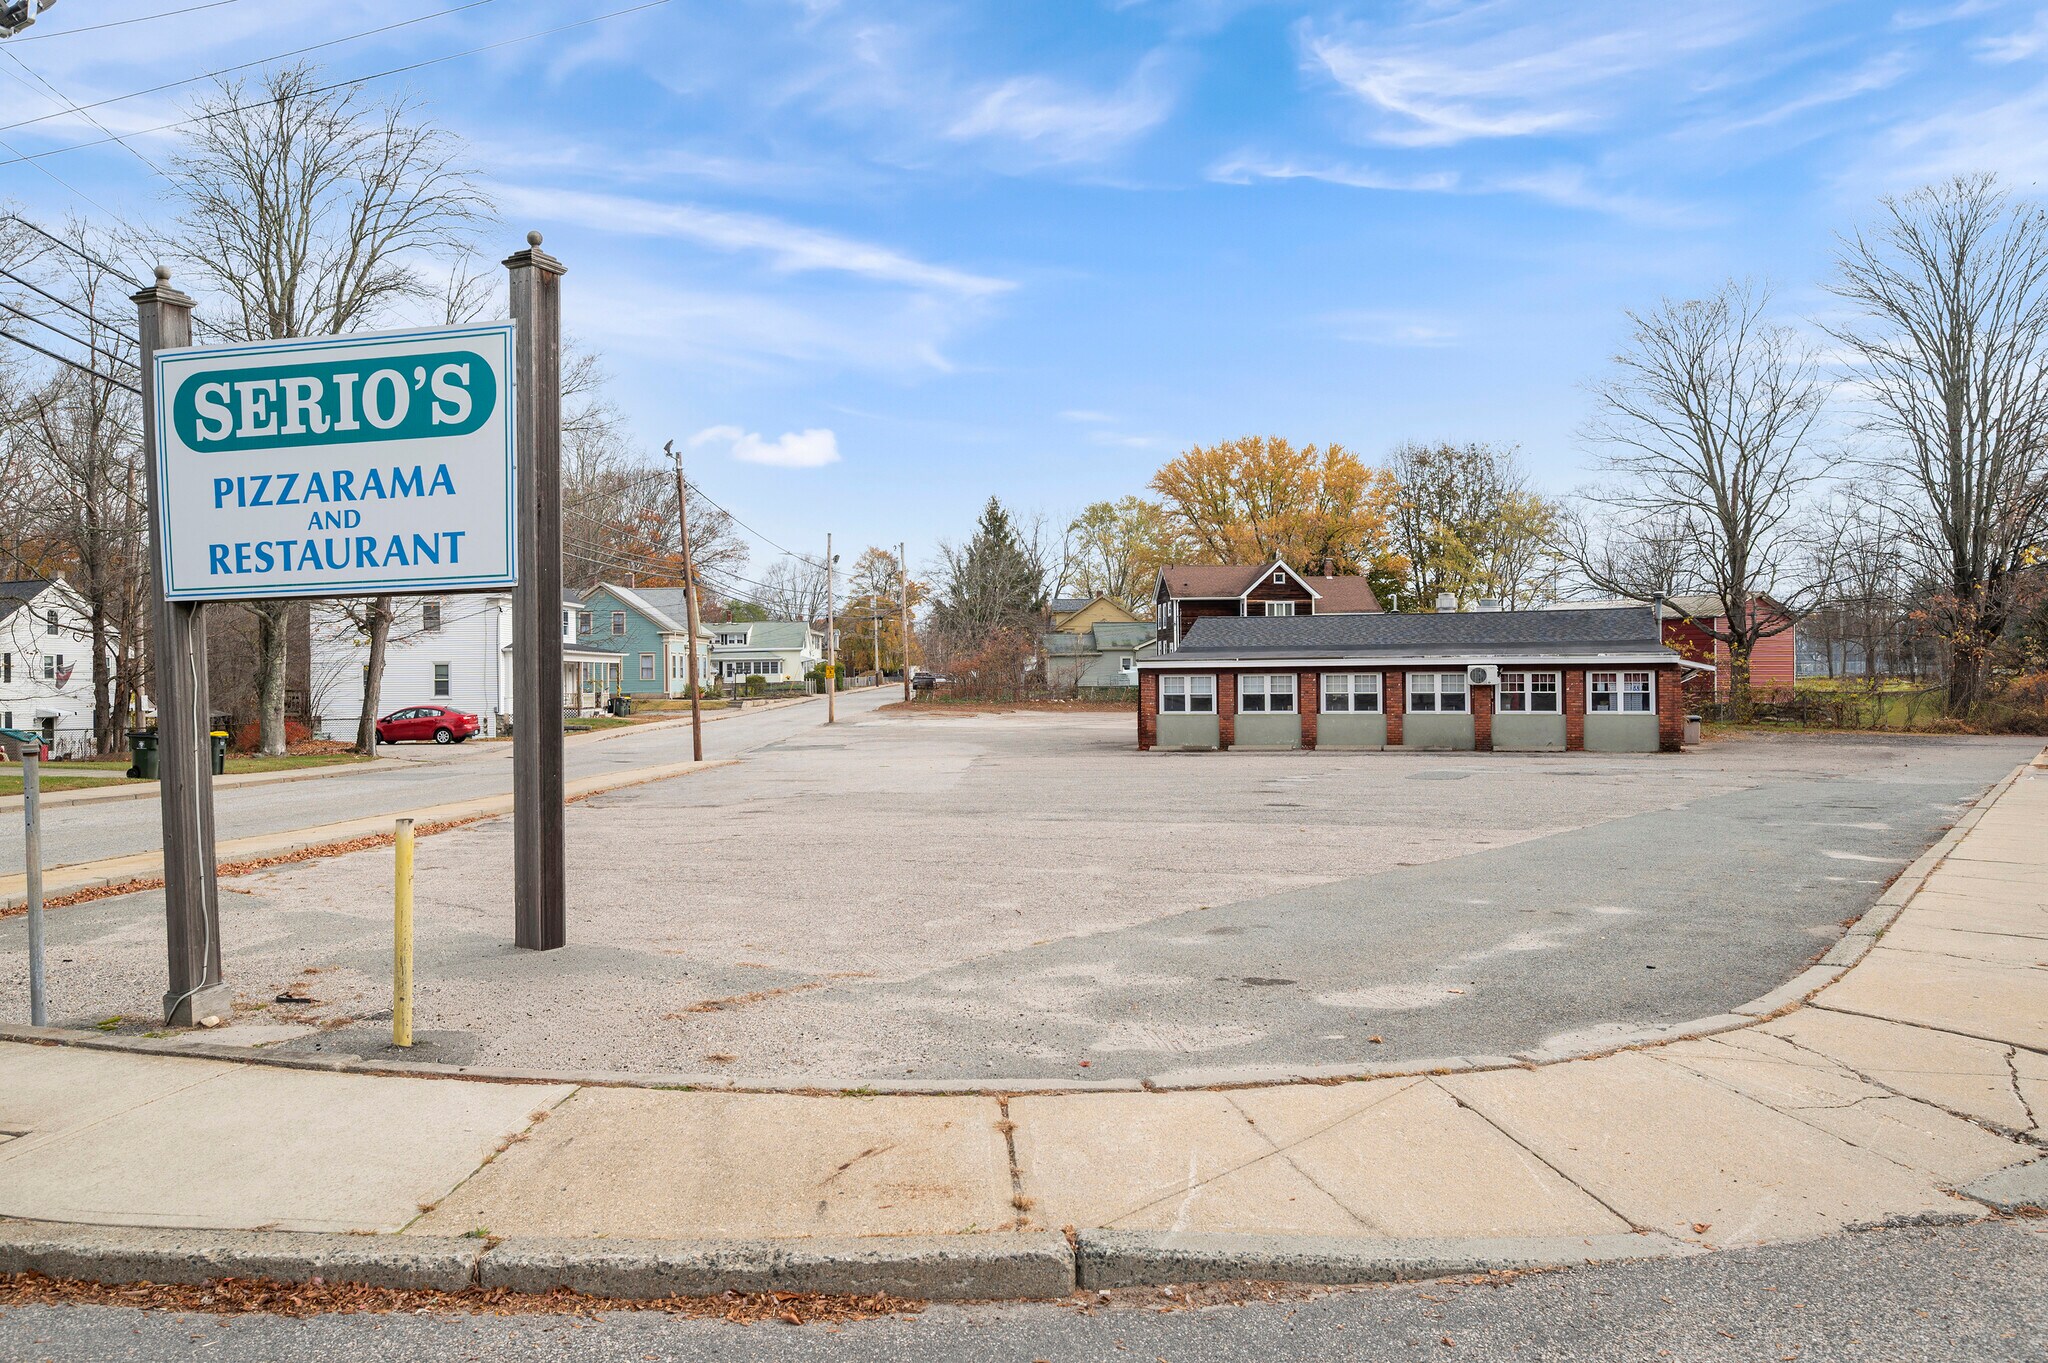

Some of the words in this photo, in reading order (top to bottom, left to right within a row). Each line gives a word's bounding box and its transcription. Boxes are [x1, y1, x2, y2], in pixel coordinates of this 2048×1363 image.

[194, 363, 473, 441] SERIO'S
[213, 463, 457, 509] PIZZARAMA
[307, 509, 361, 531] AND
[208, 530, 466, 576] RESTAURANT
